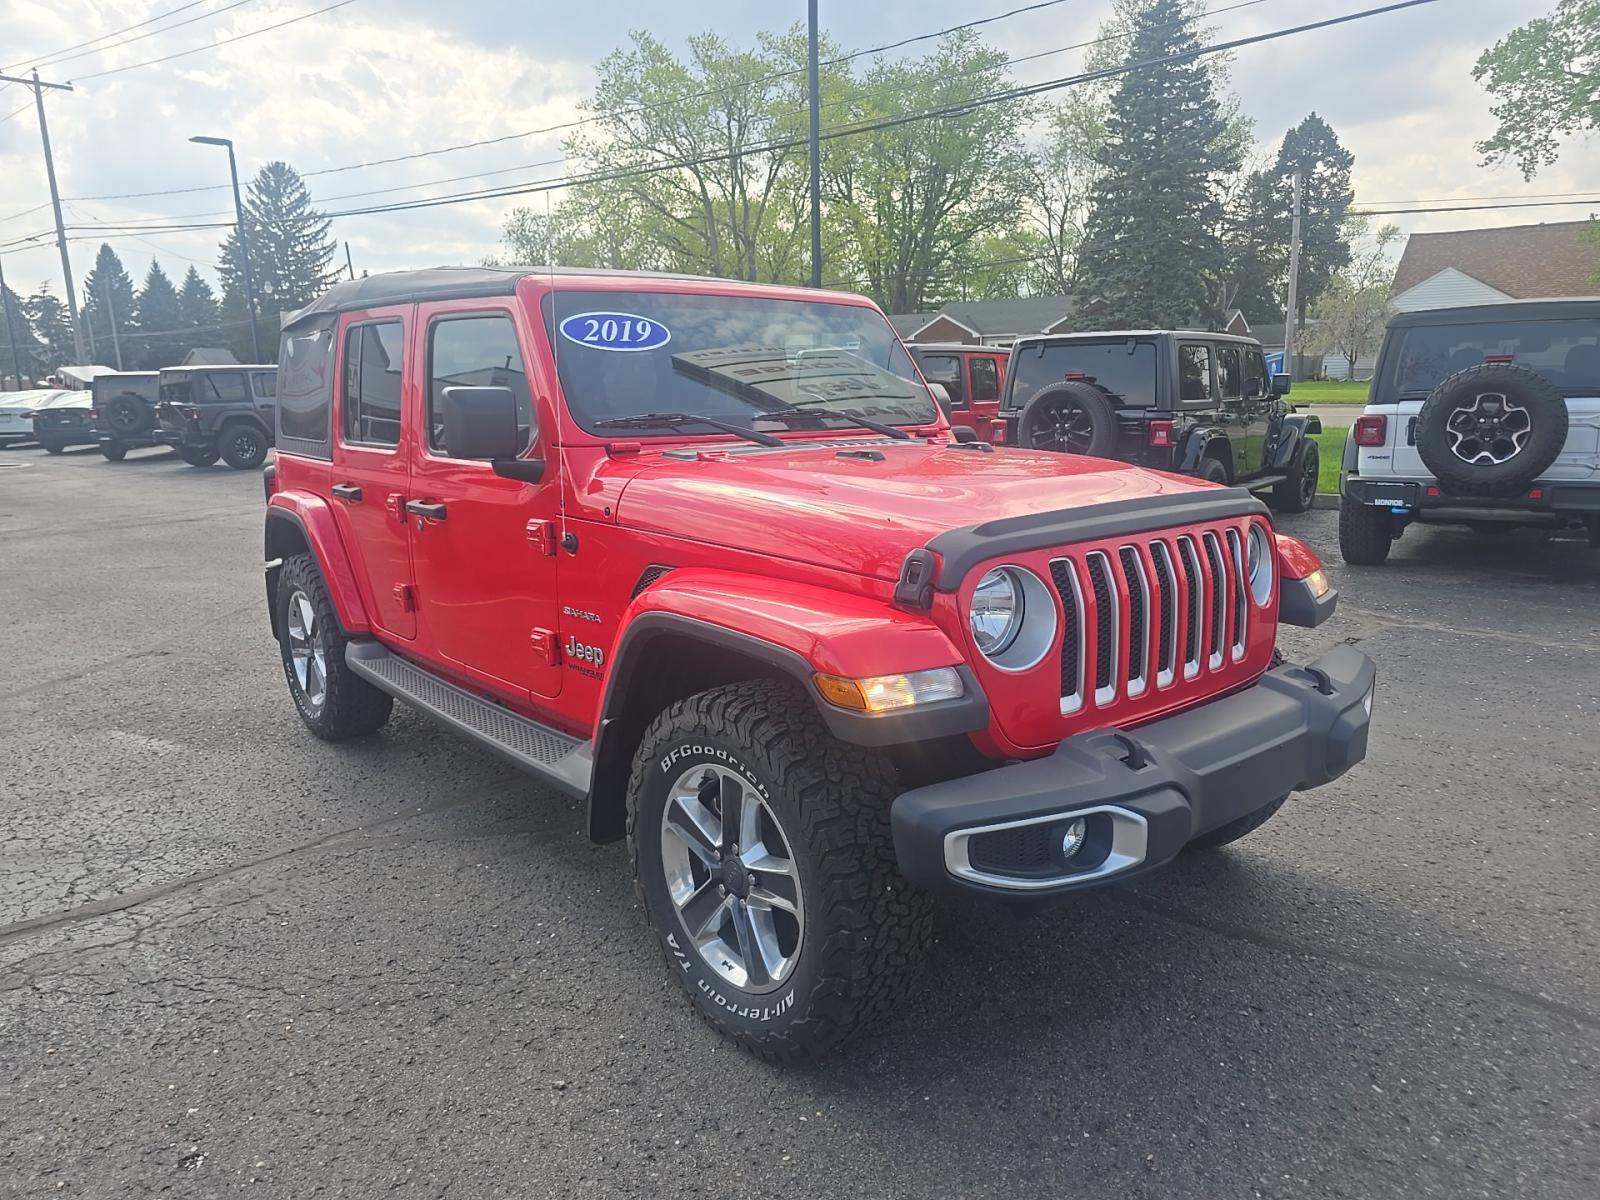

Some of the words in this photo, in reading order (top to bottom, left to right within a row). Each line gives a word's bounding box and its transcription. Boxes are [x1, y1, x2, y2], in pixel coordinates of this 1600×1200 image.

[582, 319, 652, 342] 2019
[565, 635, 605, 669] Jeep
[660, 744, 770, 799] BFGoodrich
[666, 932, 692, 973] T/A
[697, 979, 795, 1022] All-Terrain
